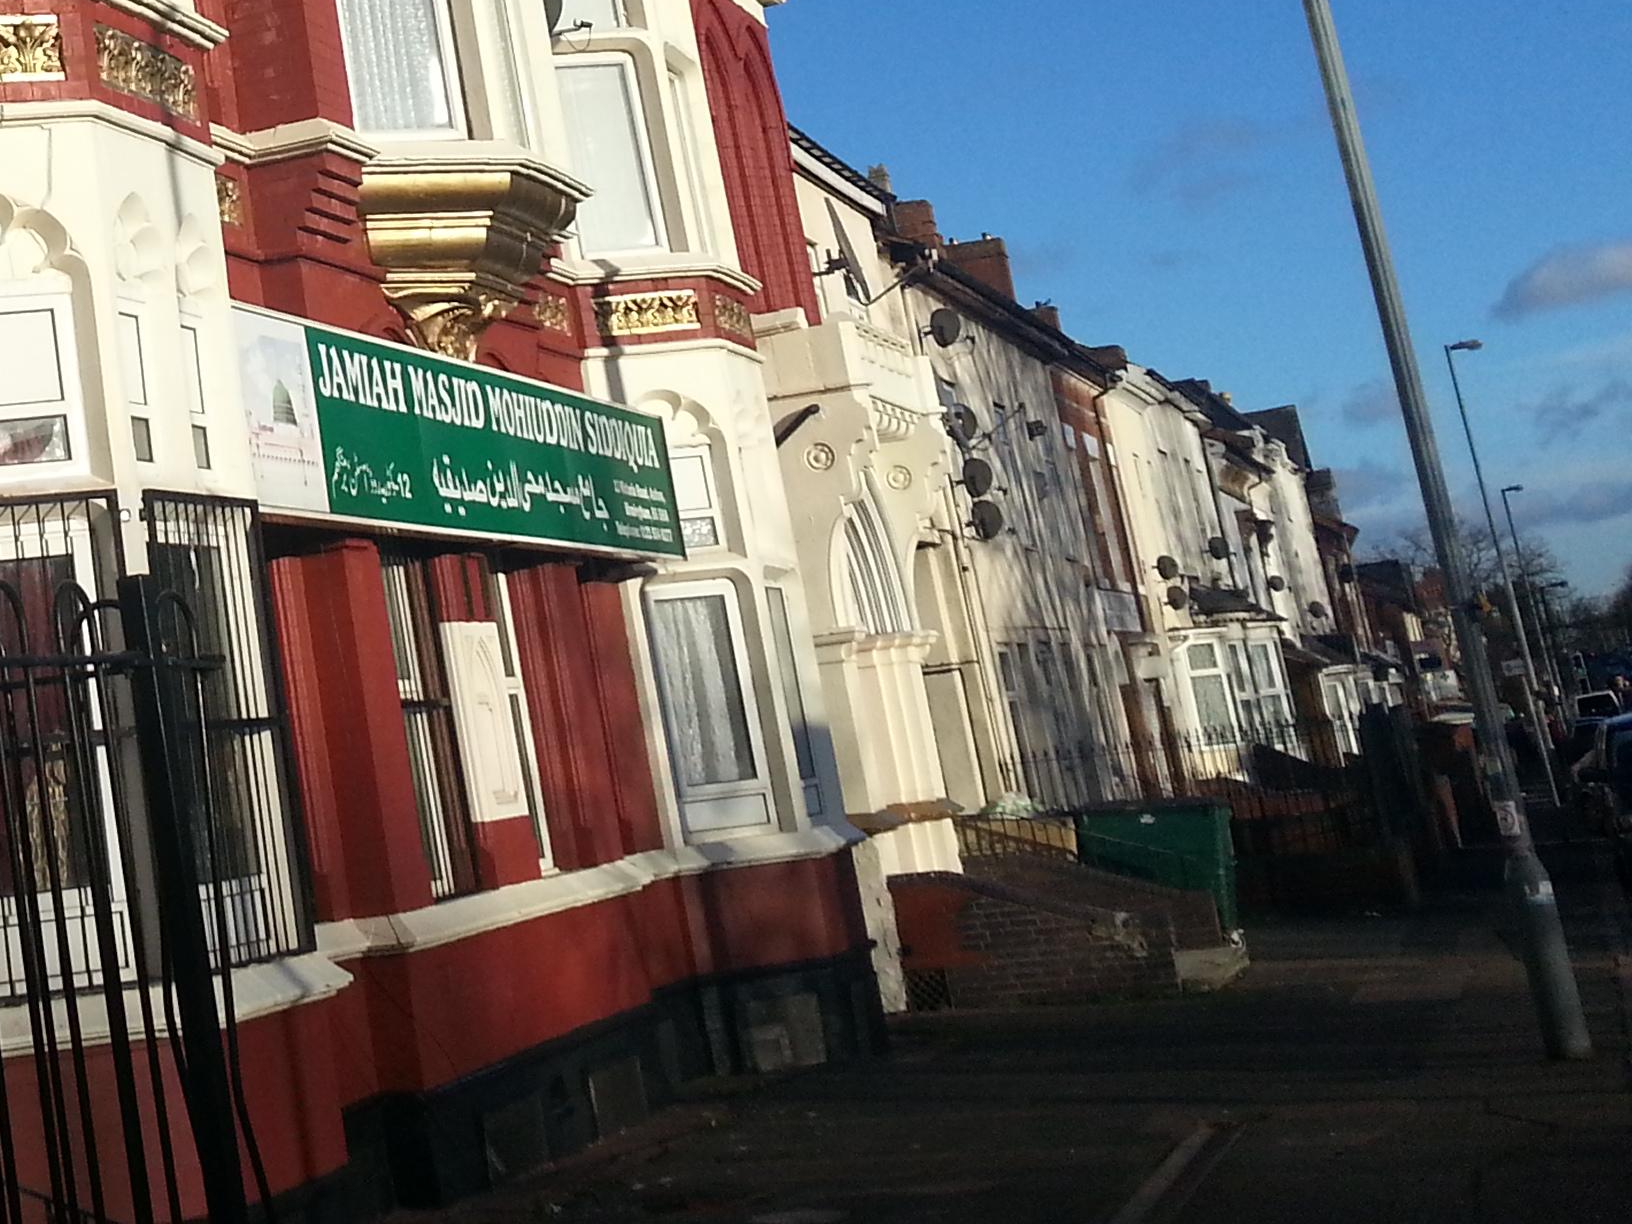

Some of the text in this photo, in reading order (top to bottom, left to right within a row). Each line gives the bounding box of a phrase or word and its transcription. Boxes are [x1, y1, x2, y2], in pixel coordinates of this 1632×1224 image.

[318, 343, 661, 473] JAMIAH MASJID MOHIUDDIN SIDDIQUIA
[577, 472, 610, 532] جامع
